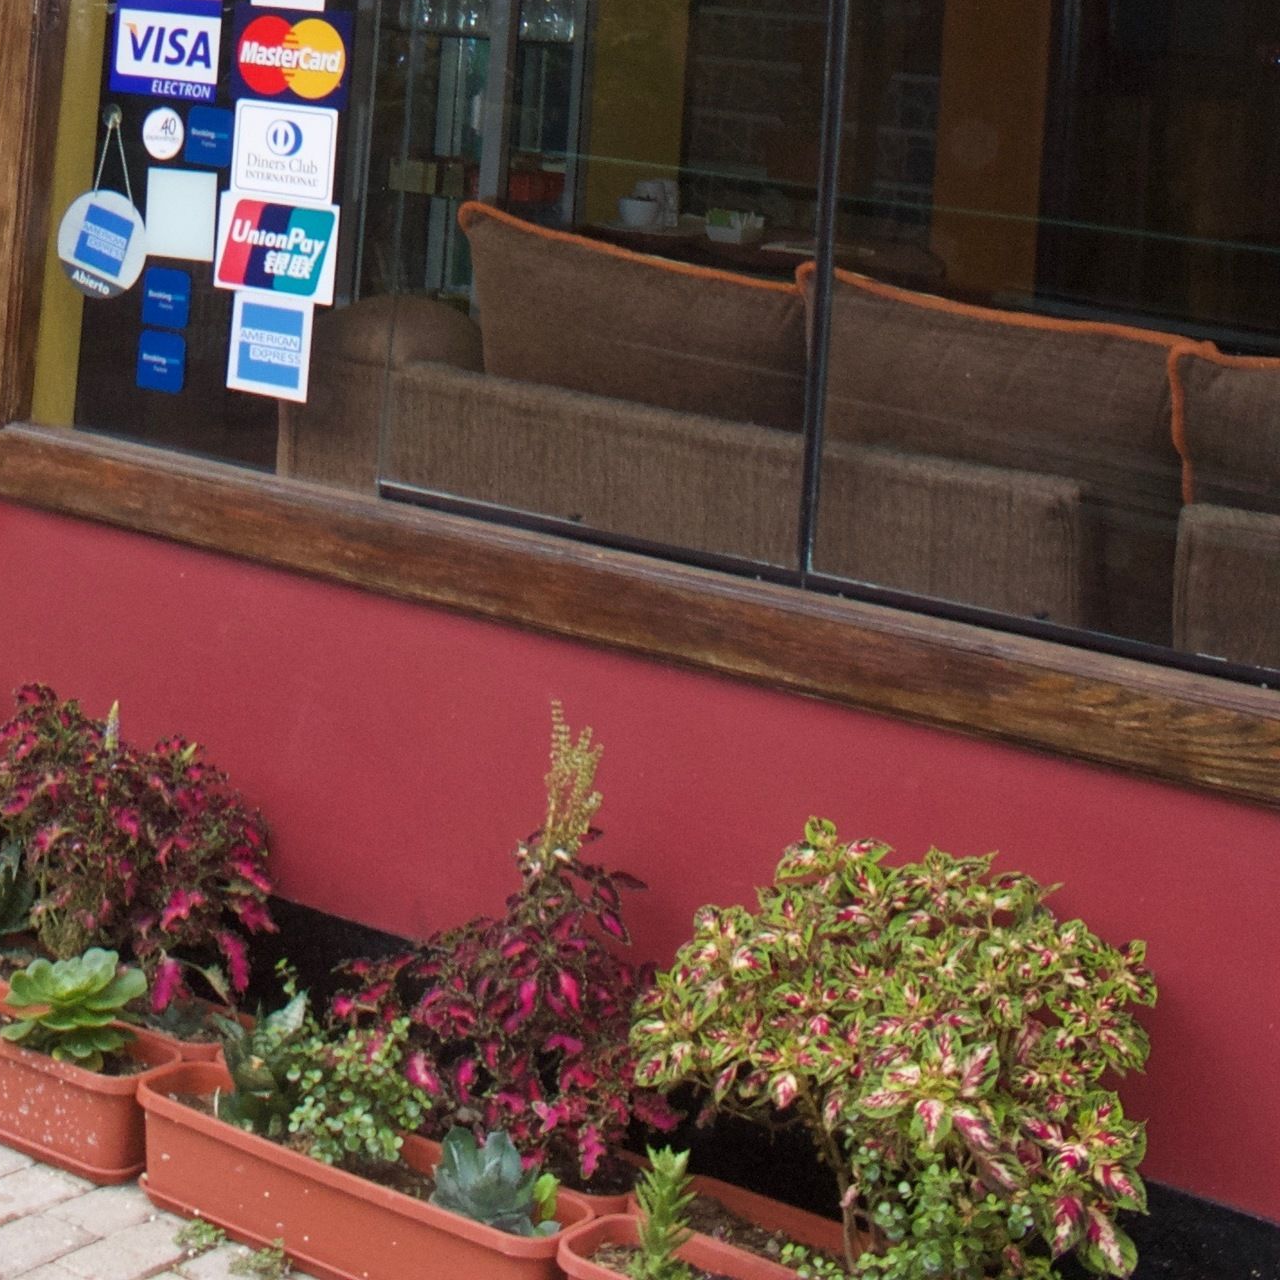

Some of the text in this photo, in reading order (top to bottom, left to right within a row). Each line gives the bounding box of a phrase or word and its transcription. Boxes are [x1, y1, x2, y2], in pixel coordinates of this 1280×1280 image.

[124, 23, 211, 69] VISA
[240, 40, 341, 73] MasterCard
[151, 79, 211, 99] ELECTRON
[161, 117, 177, 136] 40
[191, 127, 228, 140] Booking
[247, 153, 318, 175] Diners Club
[245, 170, 318, 187] INTERNATIONAL
[83, 222, 127, 247] AMERICAN
[231, 219, 325, 259] UnionPay
[263, 250, 315, 280] 银联
[72, 270, 110, 295] Abierto
[148, 289, 185, 302] Booking
[240, 328, 298, 348] AMERICAN
[142, 353, 180, 365] Booking
[251, 346, 302, 364] EXPRESS
